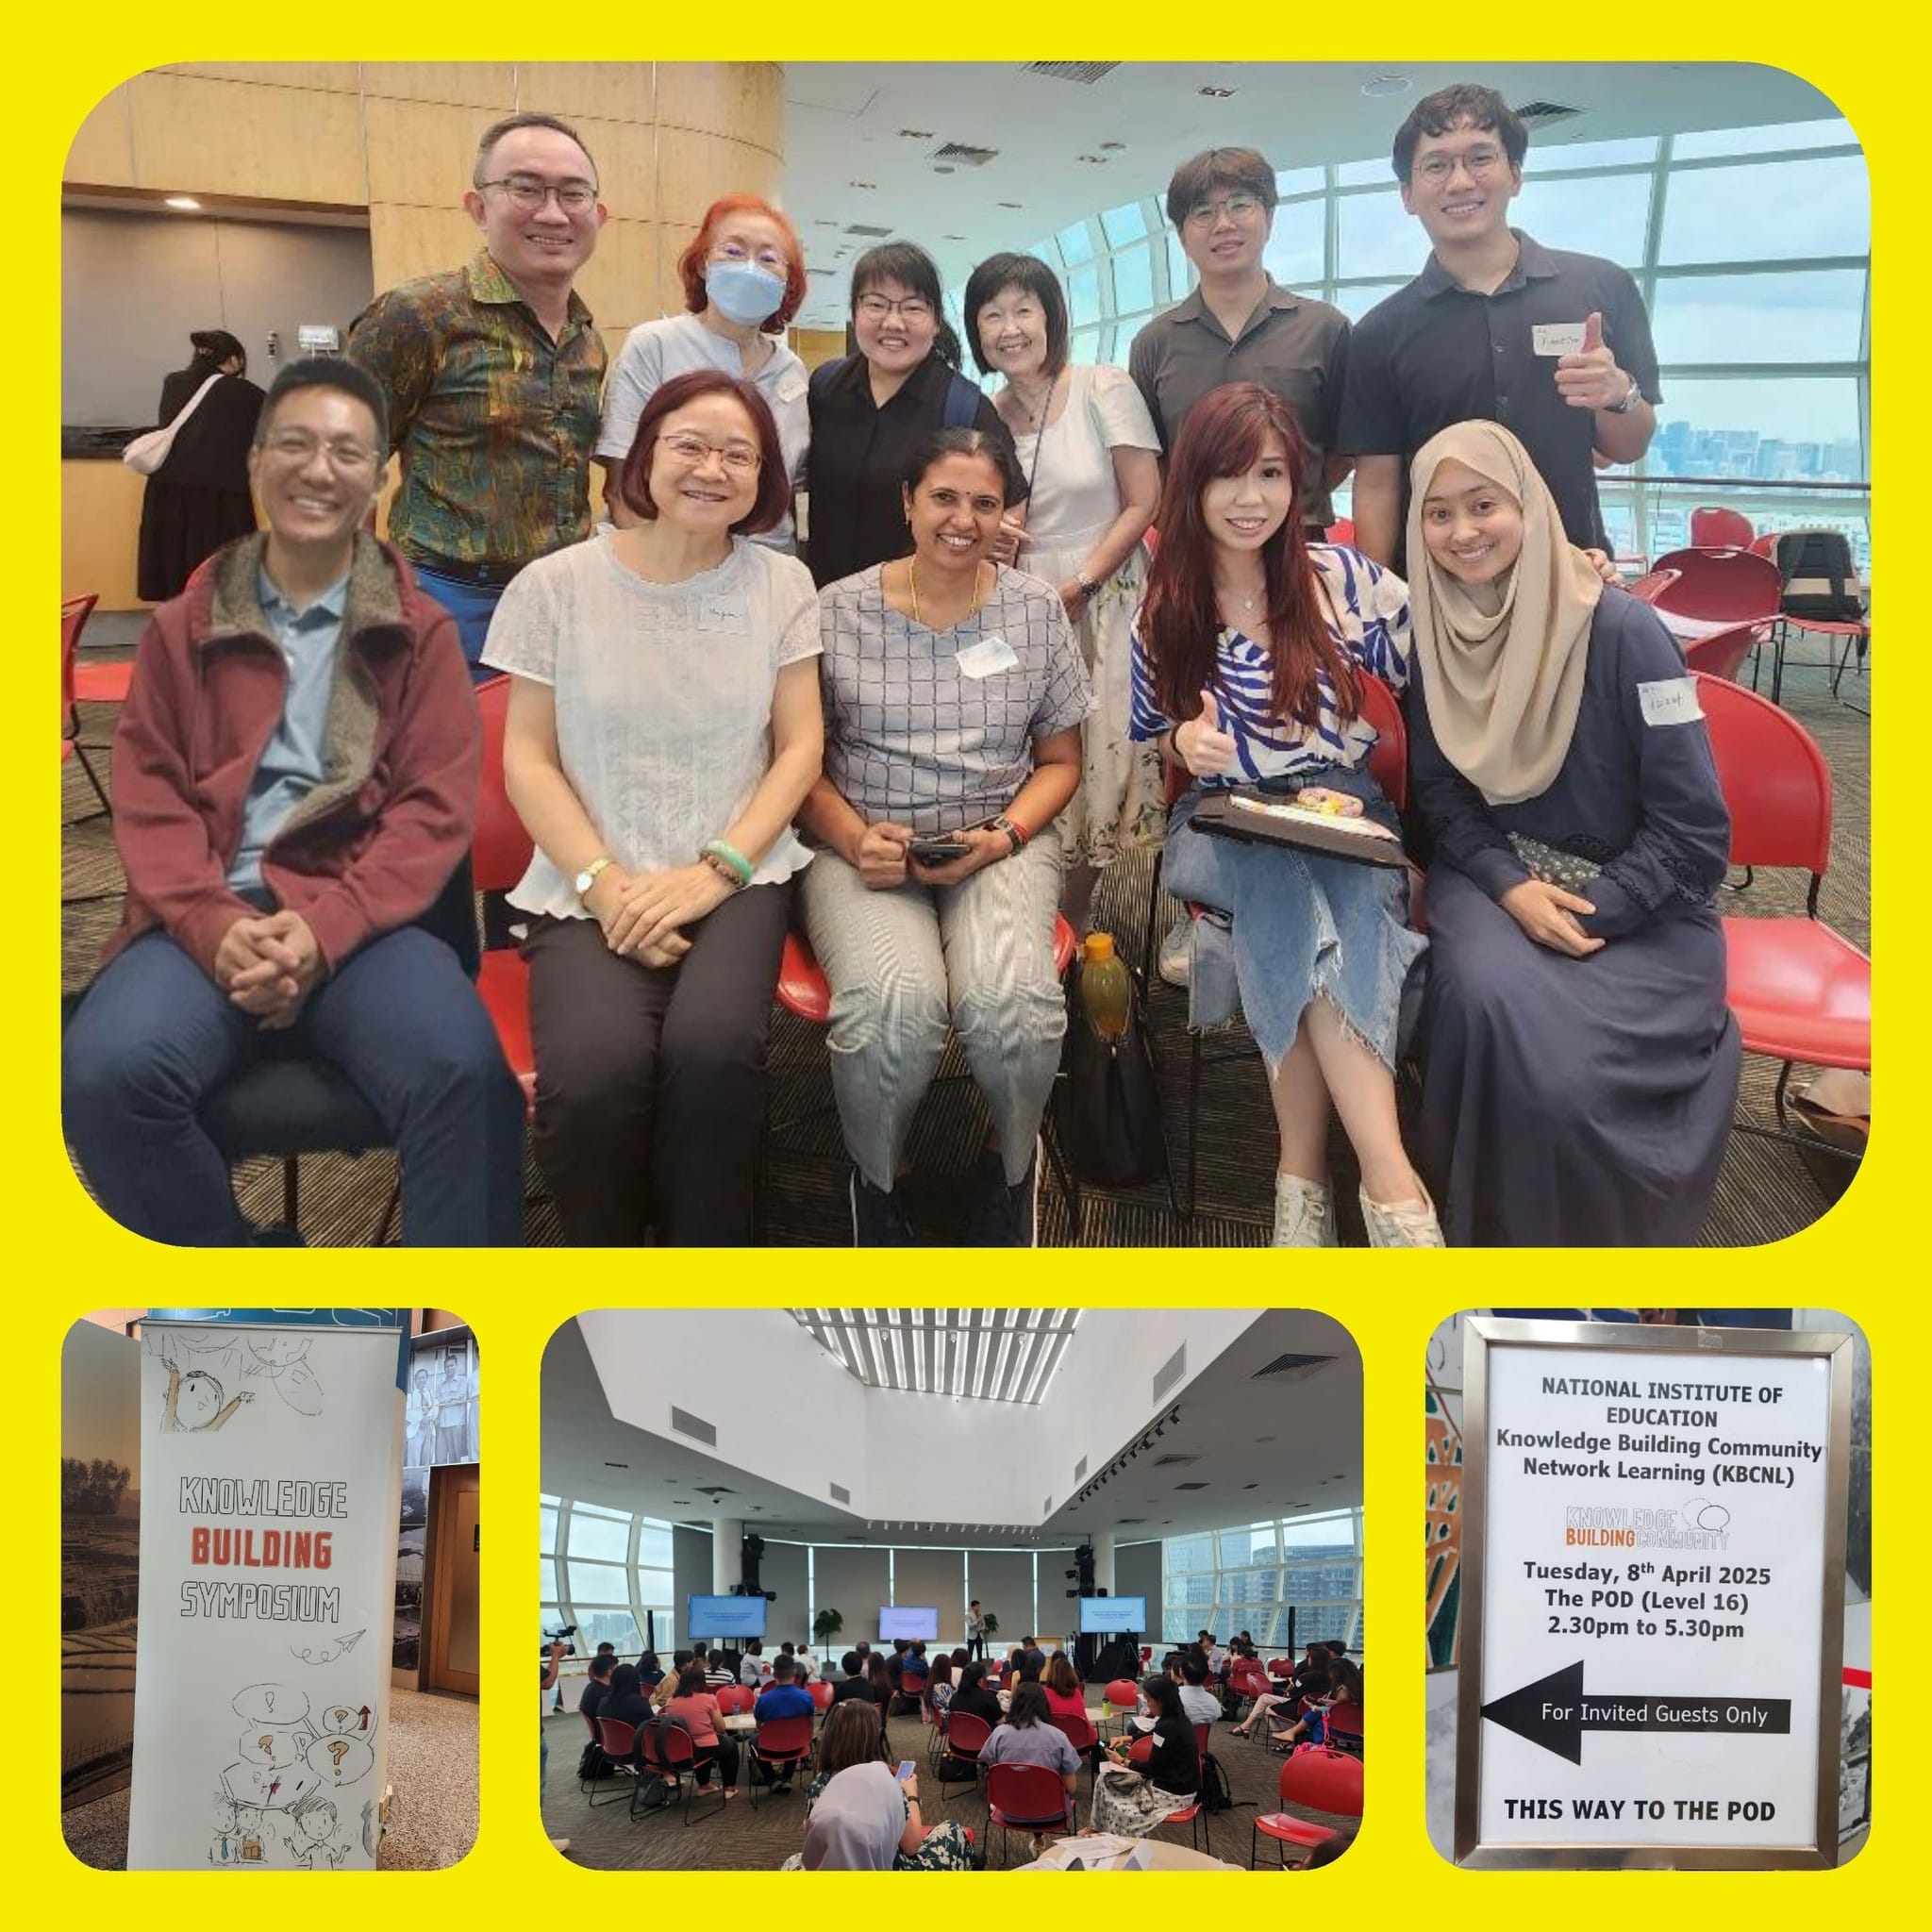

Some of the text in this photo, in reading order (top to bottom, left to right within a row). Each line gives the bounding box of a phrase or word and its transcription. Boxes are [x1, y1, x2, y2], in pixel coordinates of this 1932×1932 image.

[1542, 1376, 1783, 1404] NATIONAL INSTITUTE OF
[1607, 1407, 1718, 1428] EDUCATION
[1496, 1428, 1823, 1463] Knowledge Building Community
[1524, 1457, 1794, 1489] Network Learning (KBCNL)
[179, 1476, 348, 1519] KNOWLEDGE
[1565, 1506, 1677, 1531] KNOWLEDGE
[192, 1527, 333, 1570] BUILDING
[1523, 1561, 1620, 1585] Tuesday,
[1661, 1565, 1711, 1587] April
[1719, 1566, 1771, 1586] 2025
[180, 1580, 341, 1624] SYMPOSIUM
[1544, 1589, 1749, 1616] The POD (Level 16)
[1548, 1615, 1744, 1641] 2.30pm to 5.30pm
[1542, 1703, 1768, 1728] For Invited Guests Only
[1504, 1799, 1775, 1822] THIS WAY TO THE POD
